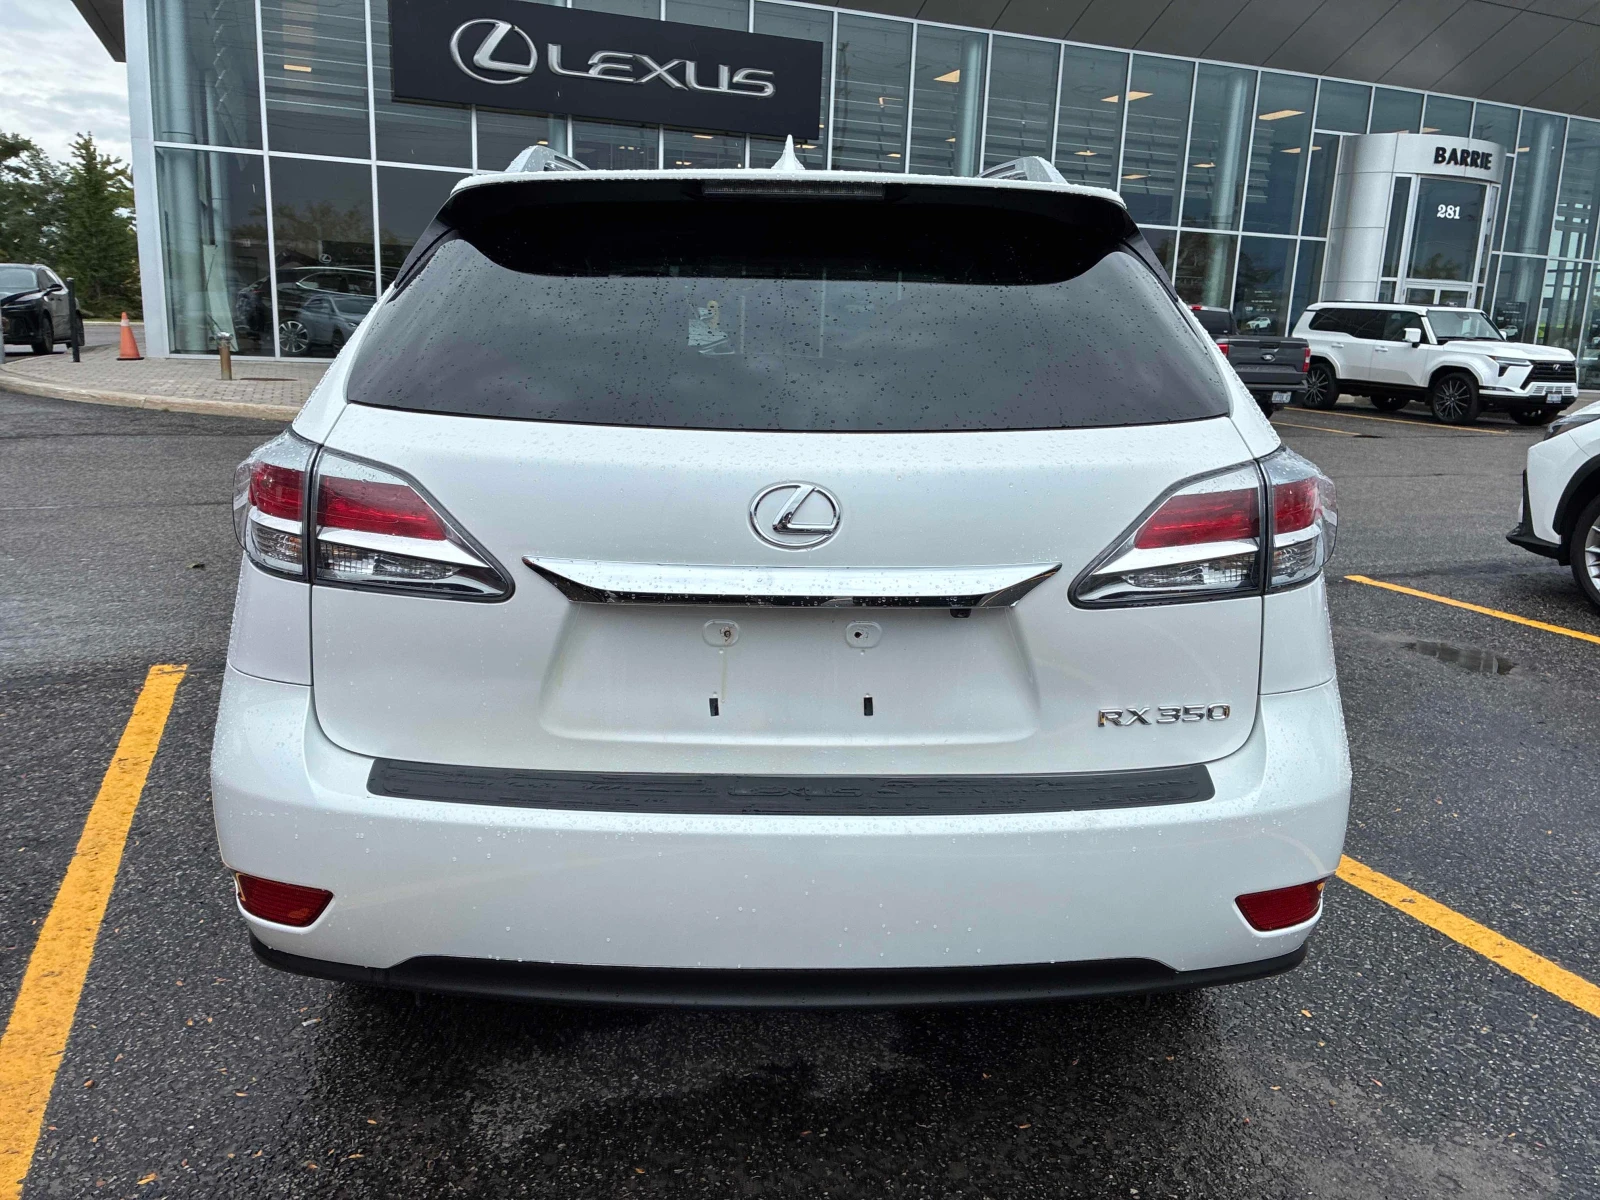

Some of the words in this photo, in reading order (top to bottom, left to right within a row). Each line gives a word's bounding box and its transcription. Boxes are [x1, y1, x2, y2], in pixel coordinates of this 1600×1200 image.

[547, 43, 776, 98] LEXUS
[1433, 146, 1493, 170] BARRIE
[1436, 204, 1461, 219] 281
[1098, 707, 1151, 727] RX
[1156, 703, 1231, 724] 350
